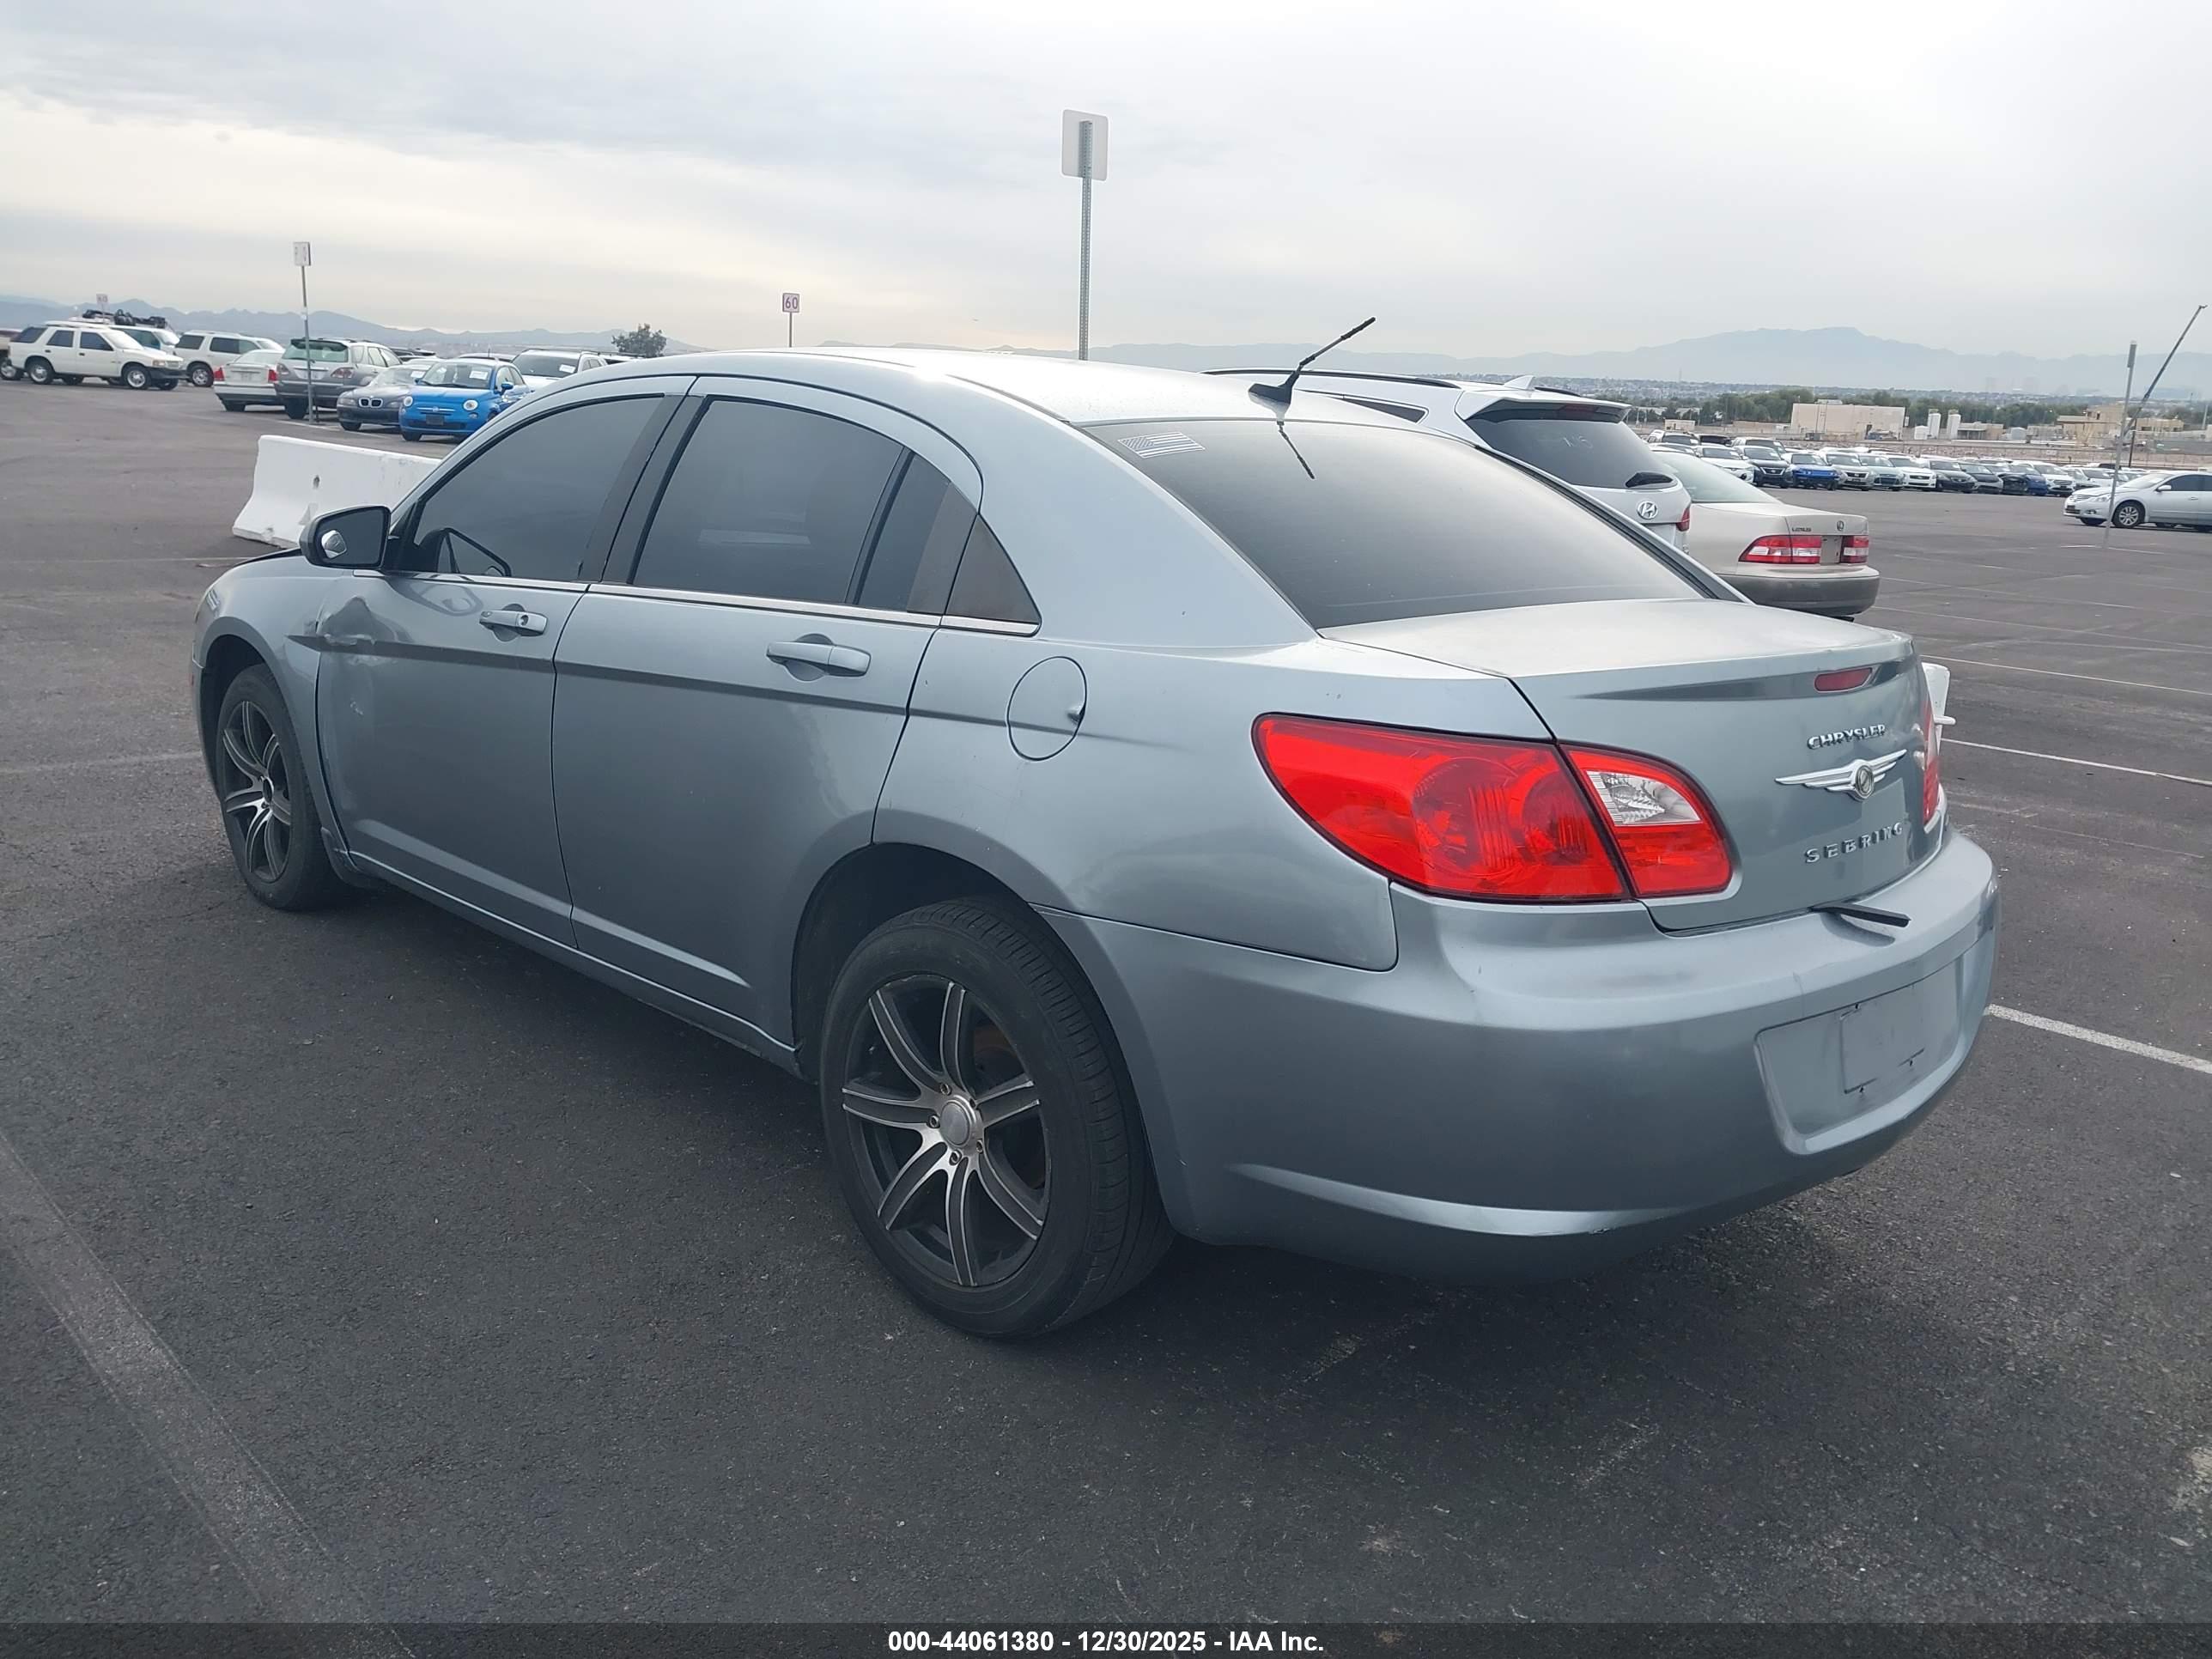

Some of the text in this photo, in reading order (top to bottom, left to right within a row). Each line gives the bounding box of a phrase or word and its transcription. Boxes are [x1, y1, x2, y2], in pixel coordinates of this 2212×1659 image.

[785, 296, 799, 310] 60
[1807, 724, 1886, 750] CHRYSLER
[1804, 822, 1903, 864] SEBRING
